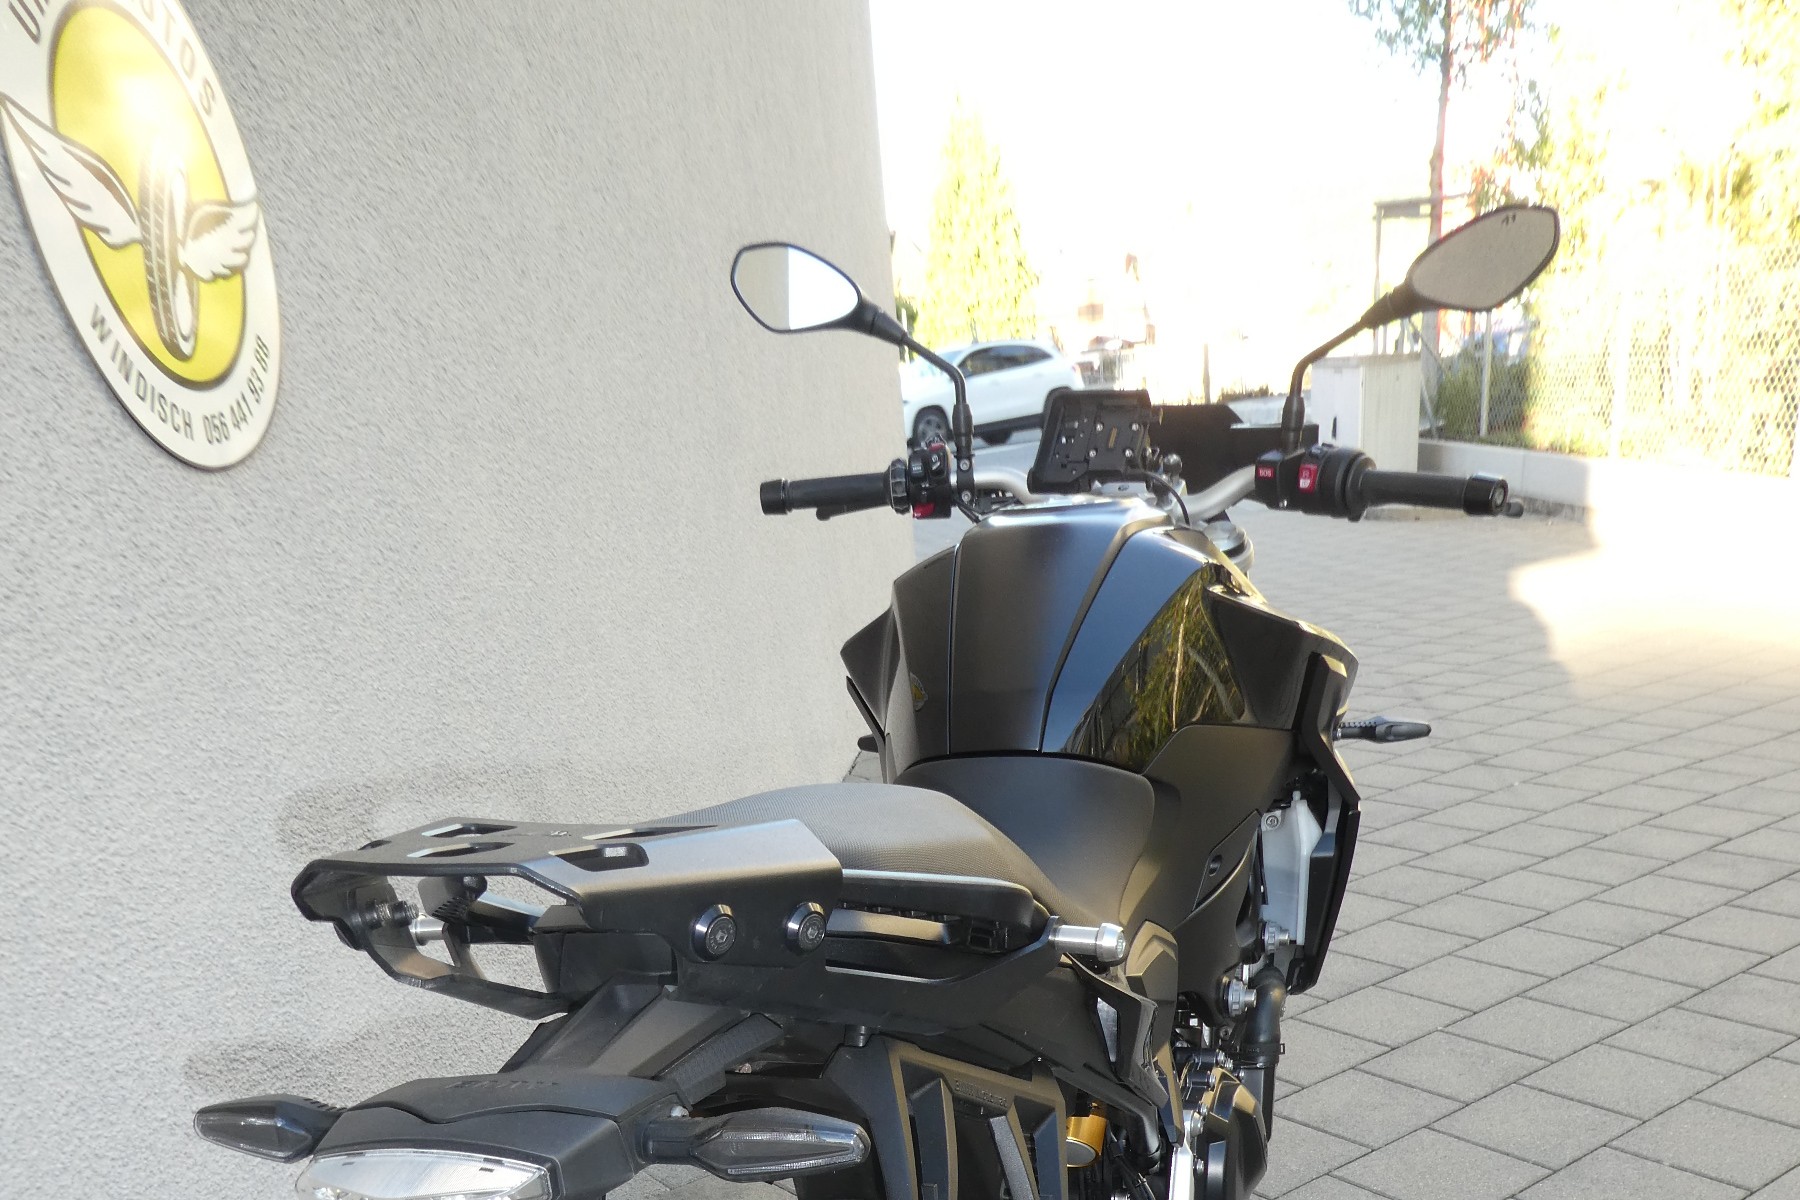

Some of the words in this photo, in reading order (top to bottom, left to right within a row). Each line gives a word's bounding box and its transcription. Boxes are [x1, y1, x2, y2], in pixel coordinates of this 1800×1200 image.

[90, 303, 195, 441] WINDISCH
[202, 411, 231, 445] 056
[229, 392, 254, 432] 441
